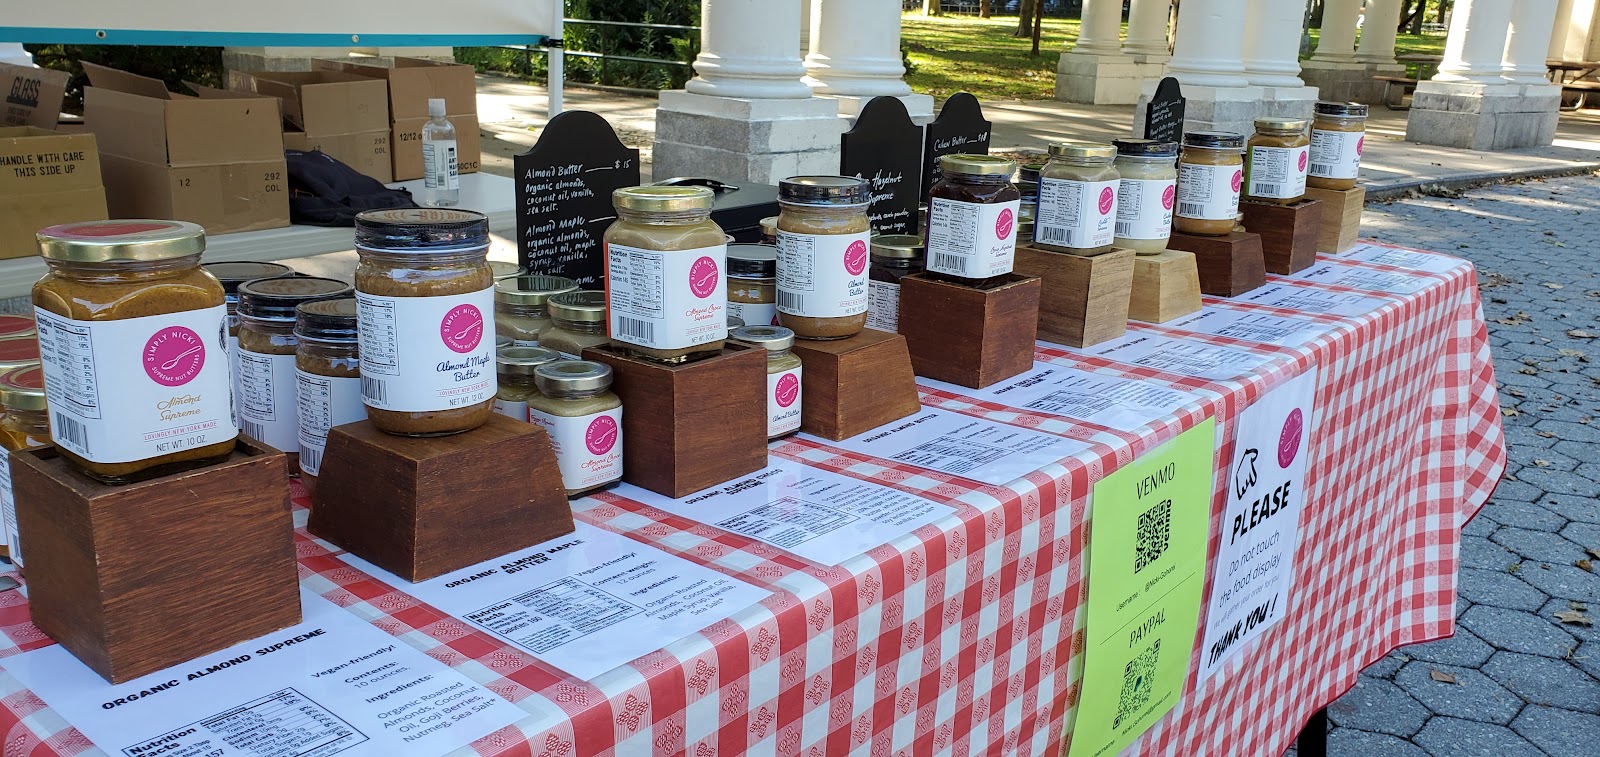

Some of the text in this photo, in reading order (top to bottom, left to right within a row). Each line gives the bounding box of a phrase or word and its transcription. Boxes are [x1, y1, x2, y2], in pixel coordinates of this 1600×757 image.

[10, 76, 40, 100] GLASS
[0, 152, 85, 166] HANDLE WITH CARE
[14, 164, 76, 177] THIS SIDE UP
[180, 178, 190, 186] 12
[264, 172, 280, 181] 292
[524, 166, 556, 180] Almond
[558, 164, 584, 176] Butter
[265, 184, 280, 192] COL
[526, 193, 556, 205] coconut
[526, 206, 539, 216] sea
[525, 216, 586, 236] Almond Maple
[528, 245, 558, 258] coconut
[575, 239, 596, 251] maple
[848, 278, 864, 288] Almond
[849, 288, 864, 296] Butter
[444, 308, 479, 333] SIMPLY NICKI
[148, 331, 196, 362] SIMPLY NICKI
[152, 366, 174, 382] SUPREME
[186, 354, 200, 376] BUTTERS
[436, 352, 490, 372] Almond Maple
[454, 372, 481, 382] Butter
[156, 394, 202, 411] Almond
[460, 396, 470, 404] WT.
[160, 408, 201, 422] Supreme
[144, 420, 217, 441] LOVINGLY NEW YORK MADE
[862, 432, 892, 442] ORGANIC
[156, 434, 208, 452] NET WT. 10 OZ.
[685, 490, 724, 504] ORGANIC
[723, 478, 757, 492] ALMOND
[1136, 461, 1176, 500] VENMO
[1230, 480, 1292, 546] PLEASE
[1164, 500, 1172, 552] venmo
[444, 538, 586, 588] ORGANIC ALMOND MAPLE
[504, 556, 552, 574] BUTTER
[575, 551, 638, 578] Vegan-friendly!
[1228, 530, 1280, 578] Do not touch
[592, 560, 658, 588] Content weight:
[615, 568, 656, 586] 12 ounces
[630, 574, 680, 597] Ingredients:
[1220, 552, 1282, 608] the food display
[645, 578, 708, 609] Organic Roasted
[645, 600, 683, 618] Almonds,
[682, 585, 714, 601] Coconut
[658, 608, 686, 622] Maple
[709, 584, 737, 598] Vanilla,
[468, 602, 512, 620] Nutrition
[476, 612, 506, 624] Facts
[690, 606, 707, 616] Sea
[499, 622, 530, 635] Calories
[1130, 608, 1166, 648] PAYPAL
[1208, 618, 1243, 669] THANK
[1242, 598, 1270, 636] YOU
[102, 628, 327, 711] ORGANIC ALMOND SUPREME
[310, 644, 398, 678] Vegan-friendly!
[344, 660, 400, 684] Contents:
[354, 664, 411, 690] 10 ounces.
[364, 674, 434, 704] Ingredients:
[377, 681, 464, 720] Organic Roasted
[383, 686, 480, 730] Almonds, Coconut
[398, 696, 484, 734] Oil, Goji Berries,
[402, 711, 472, 743] Nutmeg, Sea
[128, 727, 197, 755] Nutrition
